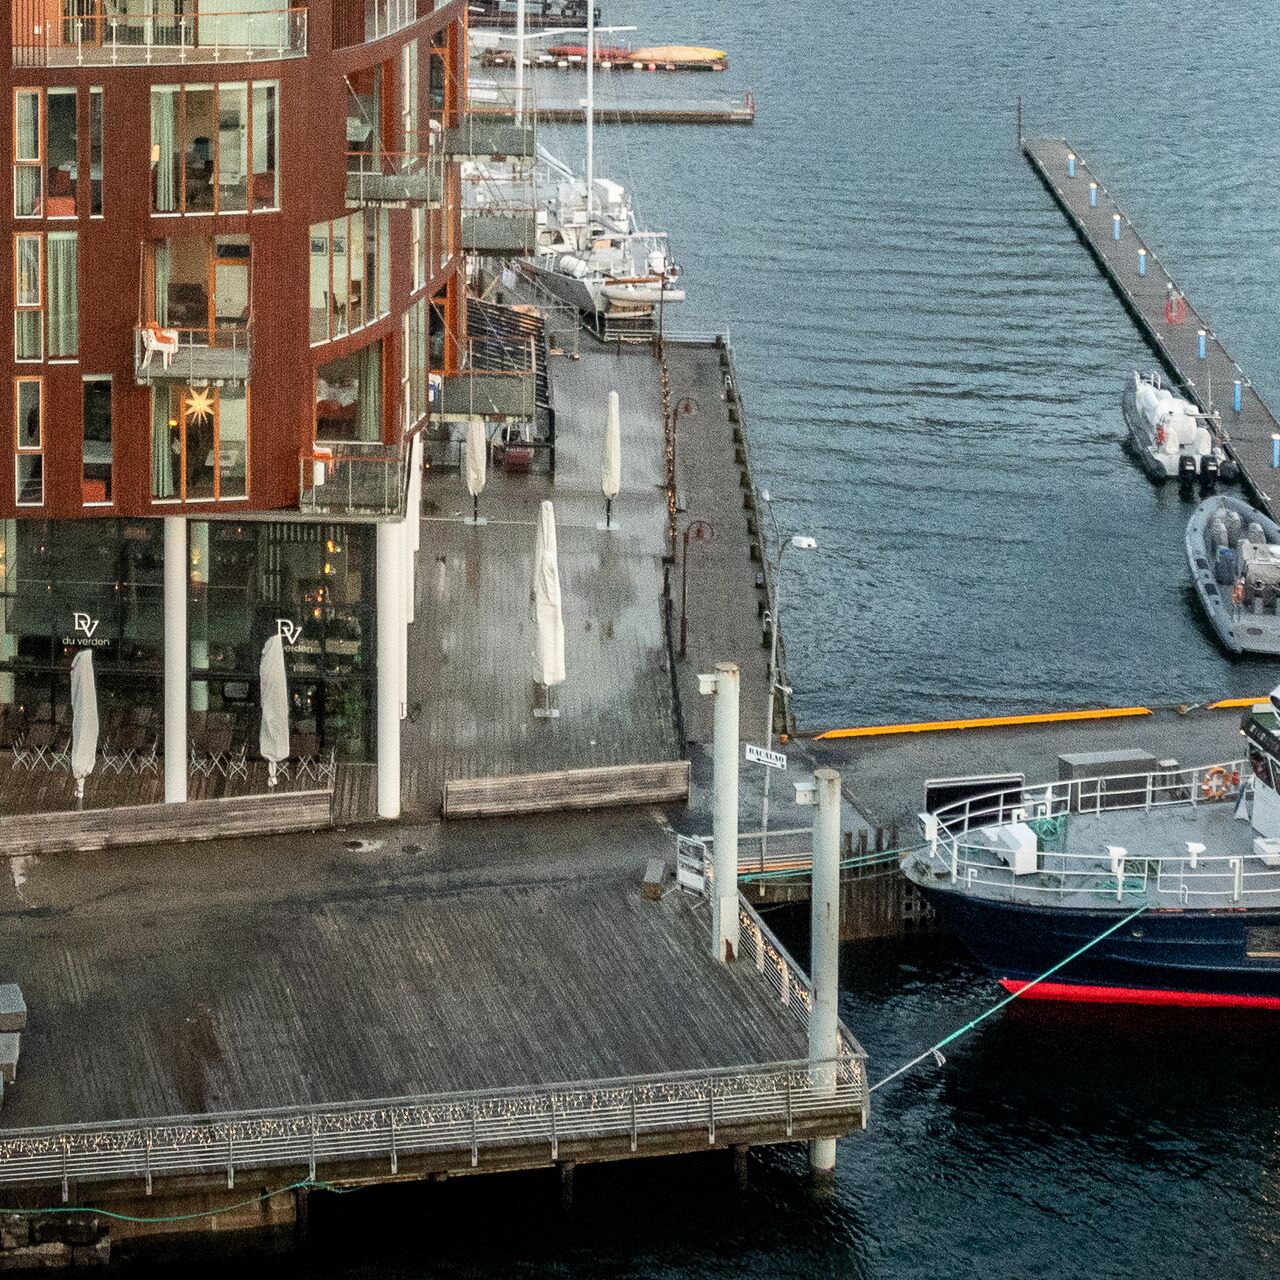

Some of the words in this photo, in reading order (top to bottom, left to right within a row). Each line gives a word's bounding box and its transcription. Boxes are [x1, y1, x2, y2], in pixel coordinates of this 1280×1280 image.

[73, 612, 99, 637] DV
[276, 619, 302, 644] DV
[62, 636, 75, 645] du
[77, 638, 110, 646] verden
